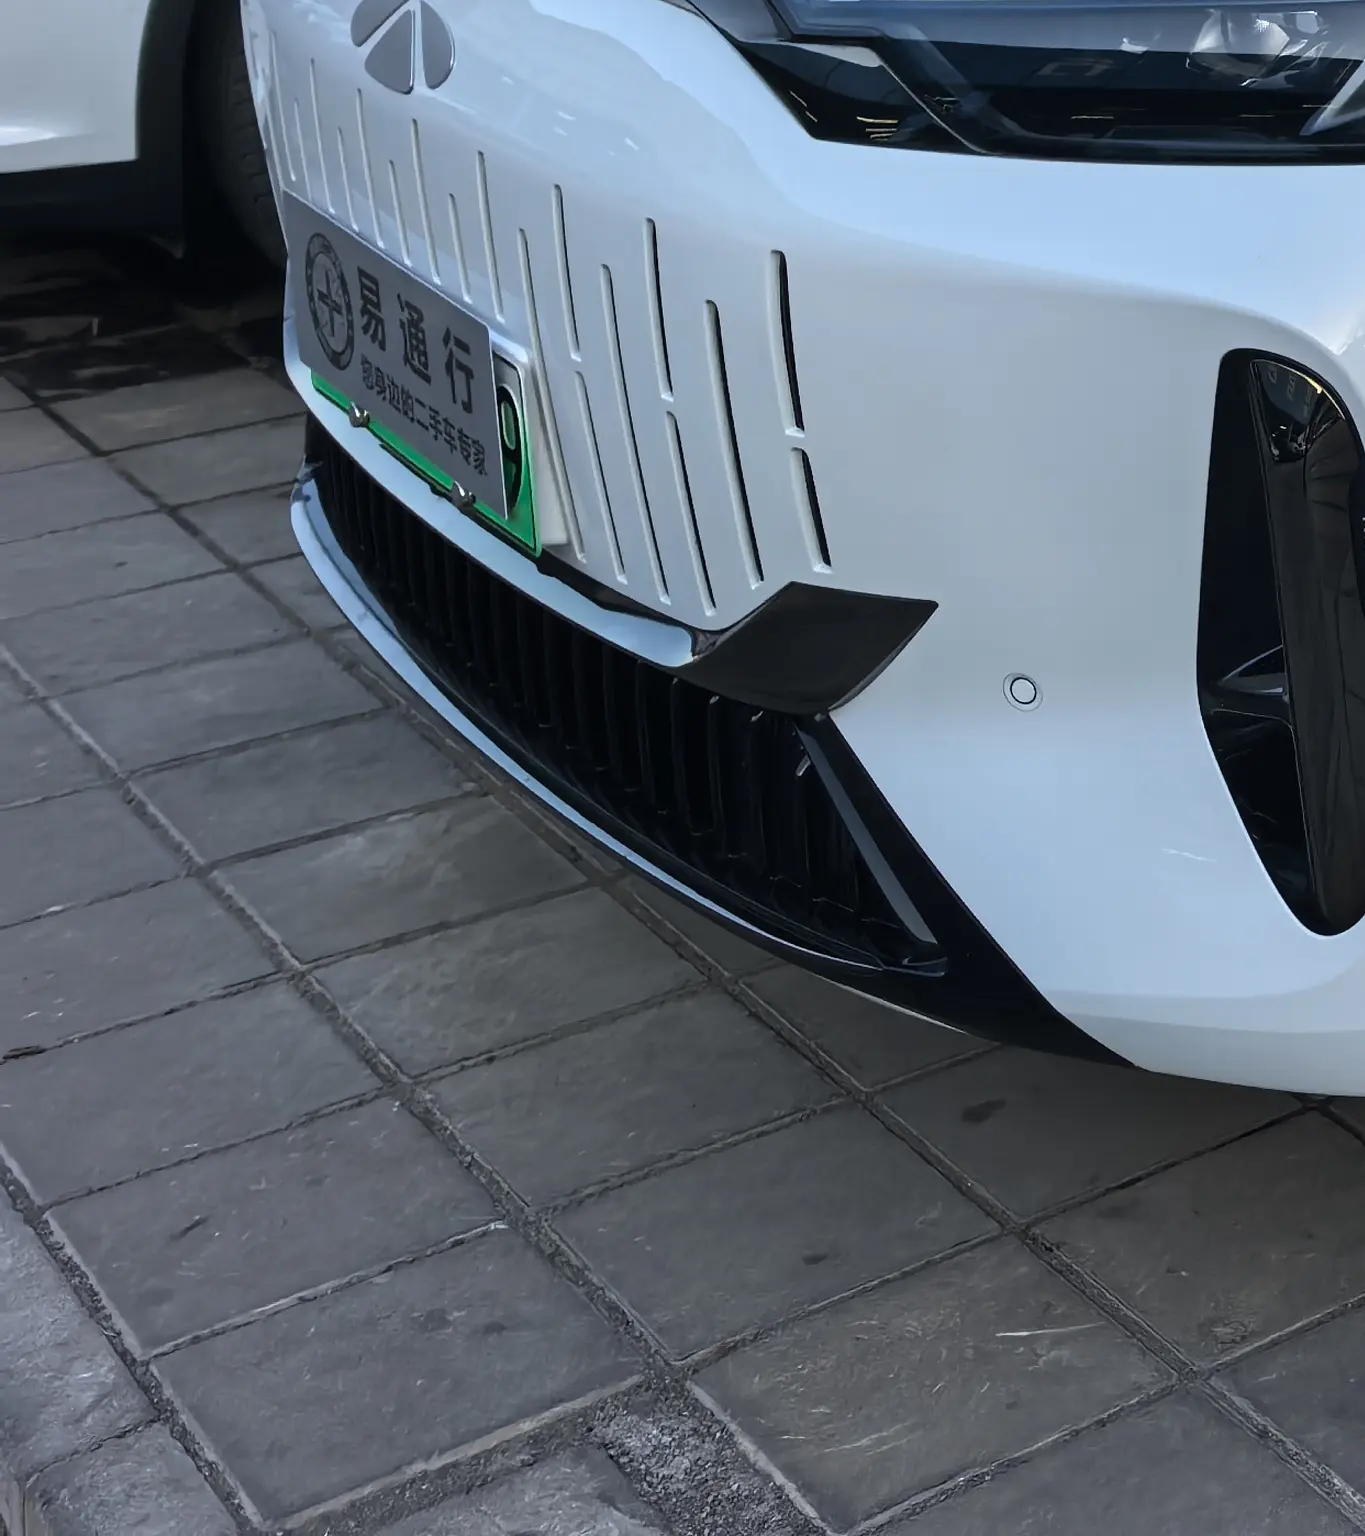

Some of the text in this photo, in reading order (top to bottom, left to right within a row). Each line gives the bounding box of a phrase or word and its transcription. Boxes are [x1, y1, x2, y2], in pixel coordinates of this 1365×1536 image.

[356, 265, 475, 414] 易通行
[360, 353, 488, 476] 您身边的二手车专家
